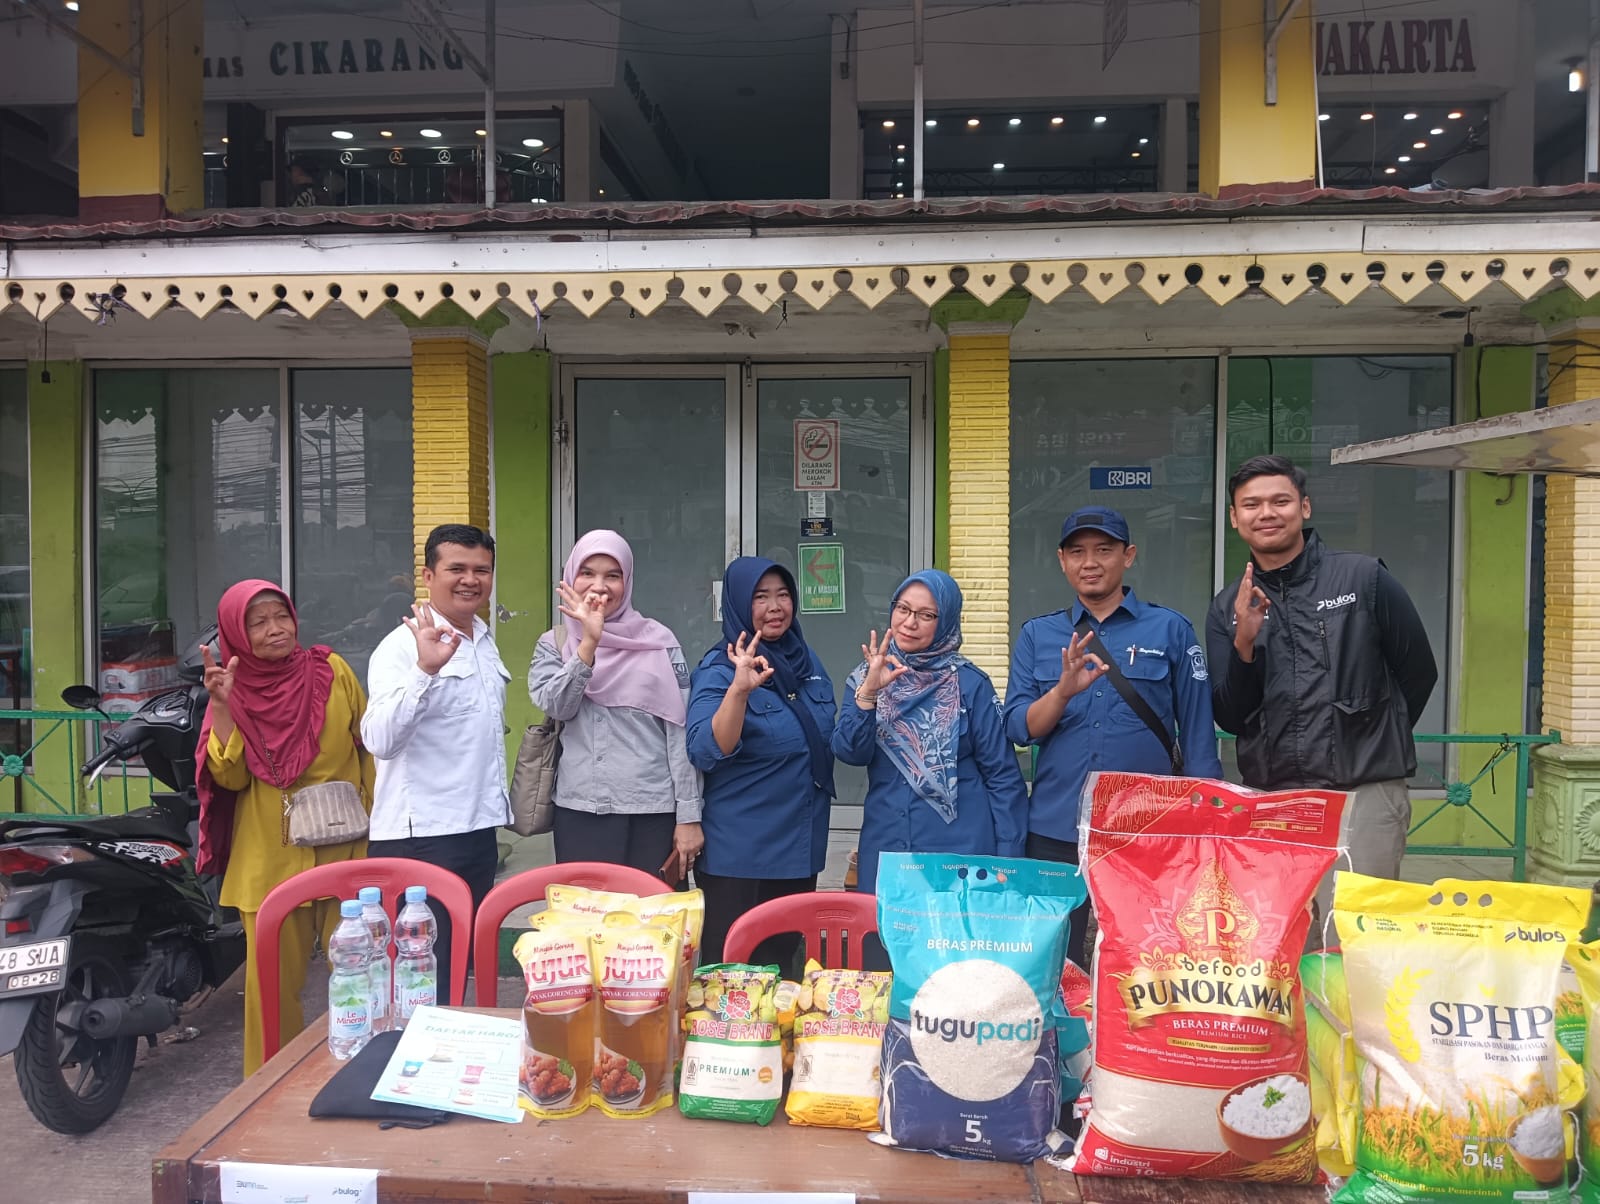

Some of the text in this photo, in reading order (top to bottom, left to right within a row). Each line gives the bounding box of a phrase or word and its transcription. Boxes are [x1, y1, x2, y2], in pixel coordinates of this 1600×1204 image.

[269, 37, 463, 76] CIKARANG
[1316, 18, 1476, 76] JAKARTA
[1125, 471, 1150, 485] BRI
[1202, 909, 1236, 947] P
[1518, 926, 1566, 943] bulog
[27, 945, 59, 966] SUA
[926, 938, 1034, 952] BERAS PREMIUM
[602, 956, 665, 985] JUJUR
[1180, 957, 1262, 978] befood
[1128, 978, 1292, 1018] PUNOKAWAN
[347, 1010, 357, 1018] Le
[1429, 1001, 1553, 1041] SPHP
[690, 1018, 774, 1040] ROSE BRAND
[803, 1019, 838, 1036] ROSE
[914, 1009, 1040, 1046] tugupadi
[1173, 1019, 1268, 1036] BERAS PREMIUM
[1196, 1030, 1247, 1040] PREMIUM RICE
[1484, 1052, 1548, 1062] Beras Medium
[699, 1064, 750, 1077] PREMIUM
[964, 1120, 992, 1146] 5 kg
[1110, 1154, 1151, 1168] industri
[1462, 1144, 1504, 1170] 5 kg
[1419, 1183, 1446, 1194] Beras
[1448, 1186, 1503, 1197] Pemerintah
